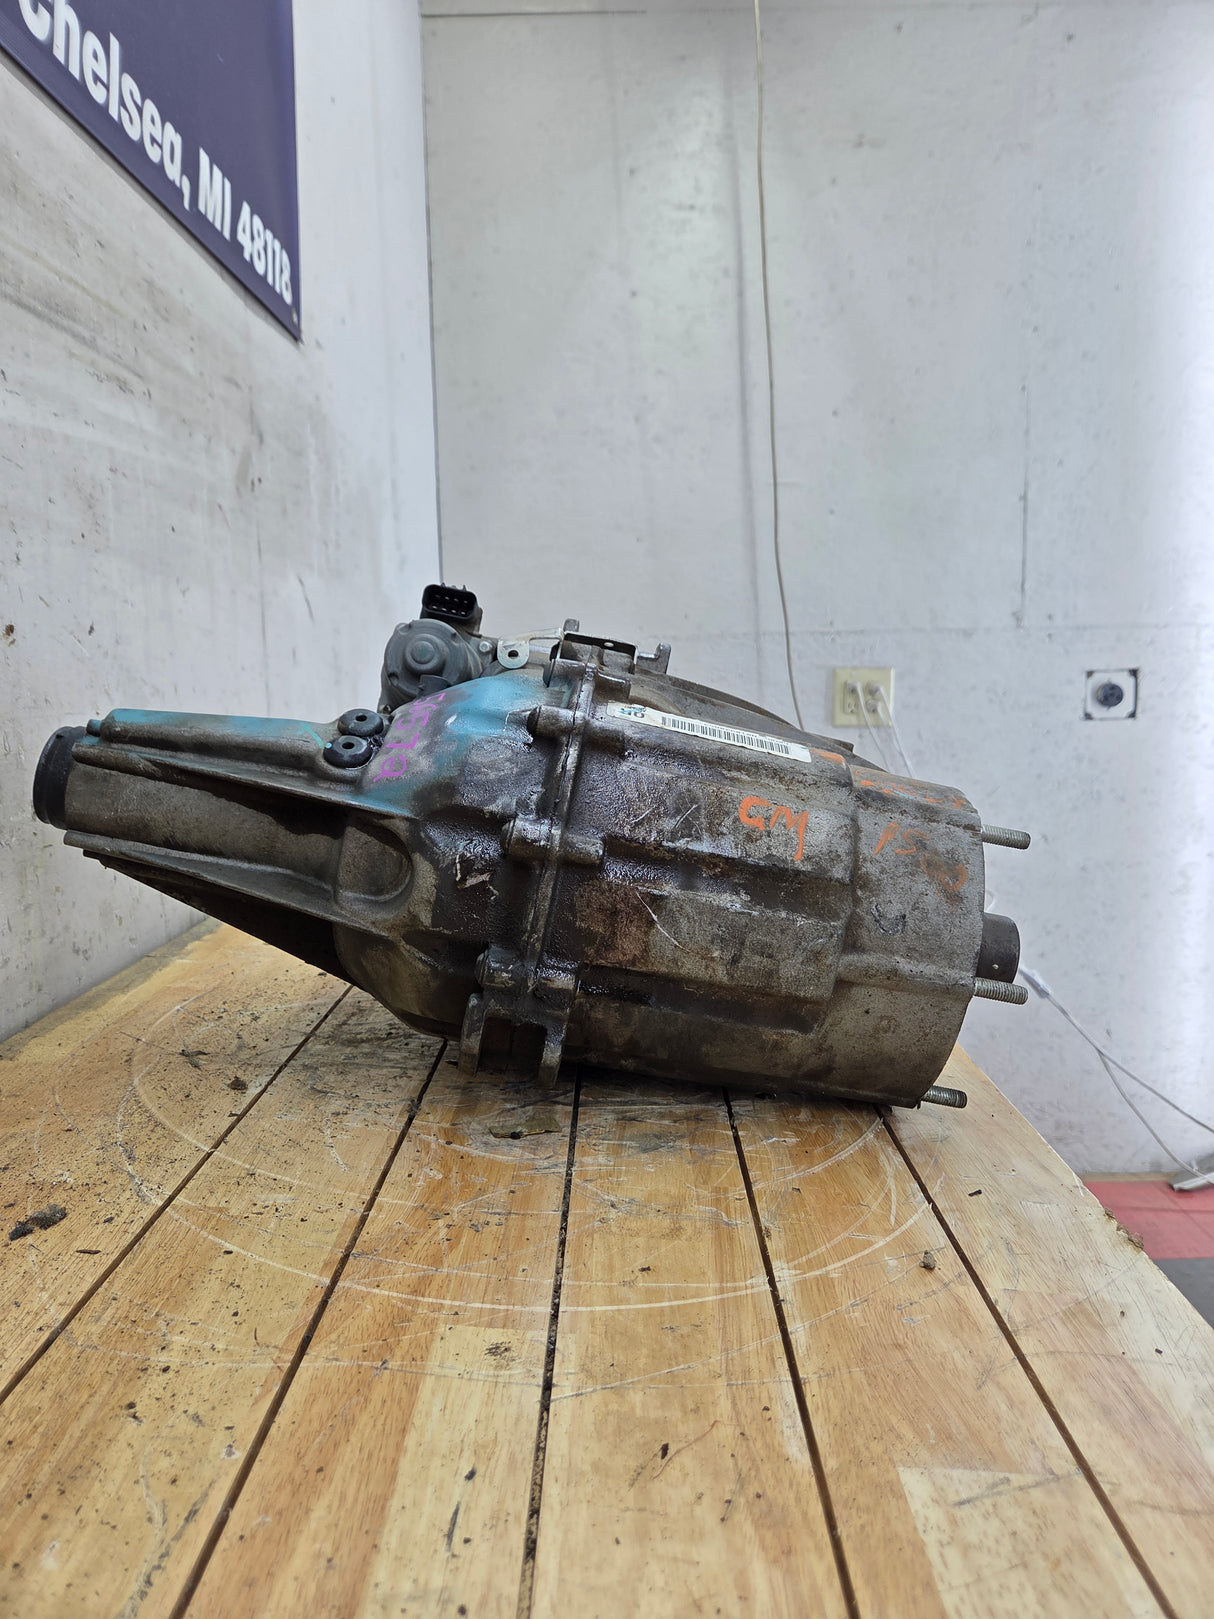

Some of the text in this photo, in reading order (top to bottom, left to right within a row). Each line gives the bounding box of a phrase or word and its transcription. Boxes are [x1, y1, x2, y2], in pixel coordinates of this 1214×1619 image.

[198, 147, 232, 241] MI
[236, 200, 293, 305] 48118
[738, 796, 809, 861] GM
